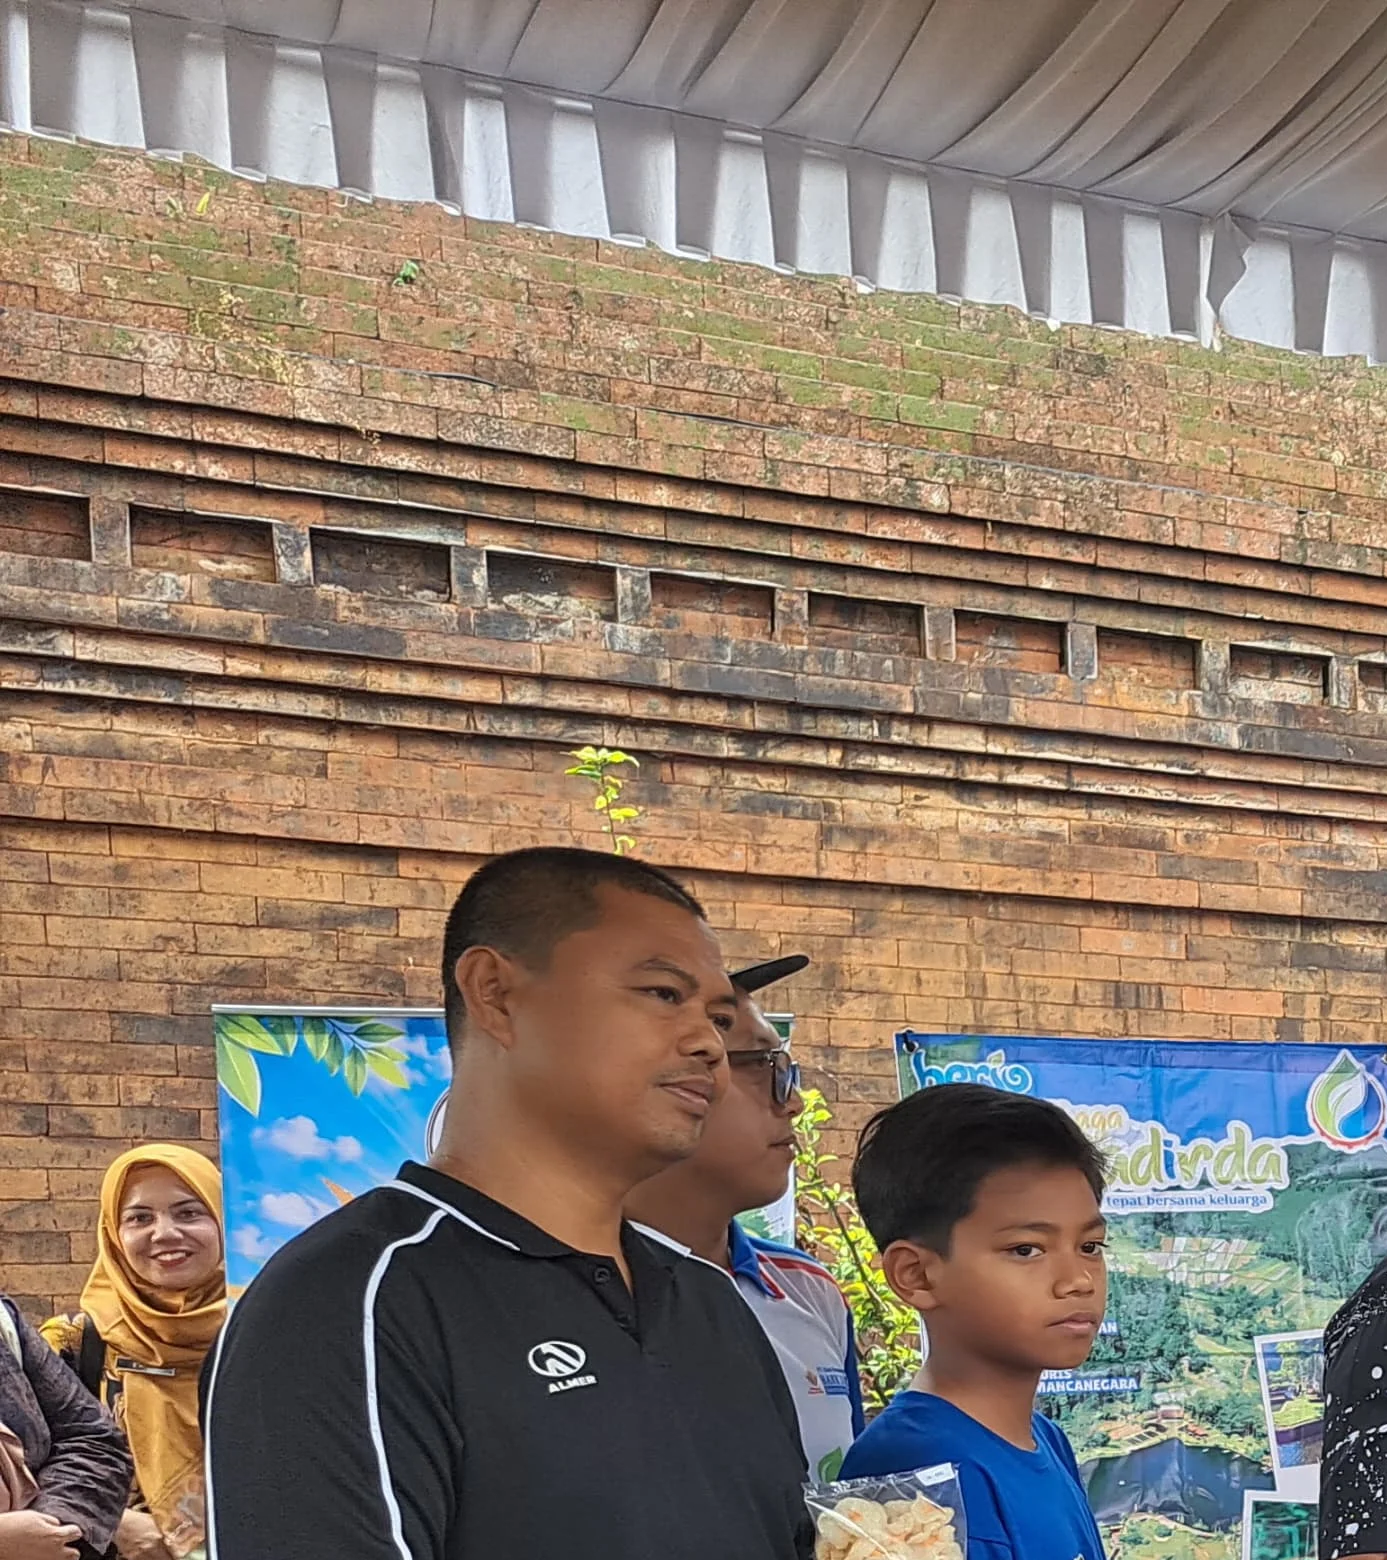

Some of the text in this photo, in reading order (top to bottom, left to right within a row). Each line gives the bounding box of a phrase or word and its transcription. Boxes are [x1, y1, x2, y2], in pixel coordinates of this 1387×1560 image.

[1106, 1126, 1283, 1185] adirda
[1107, 1191, 1268, 1209] tepat bersama keluarga
[548, 1374, 598, 1394] ALMER
